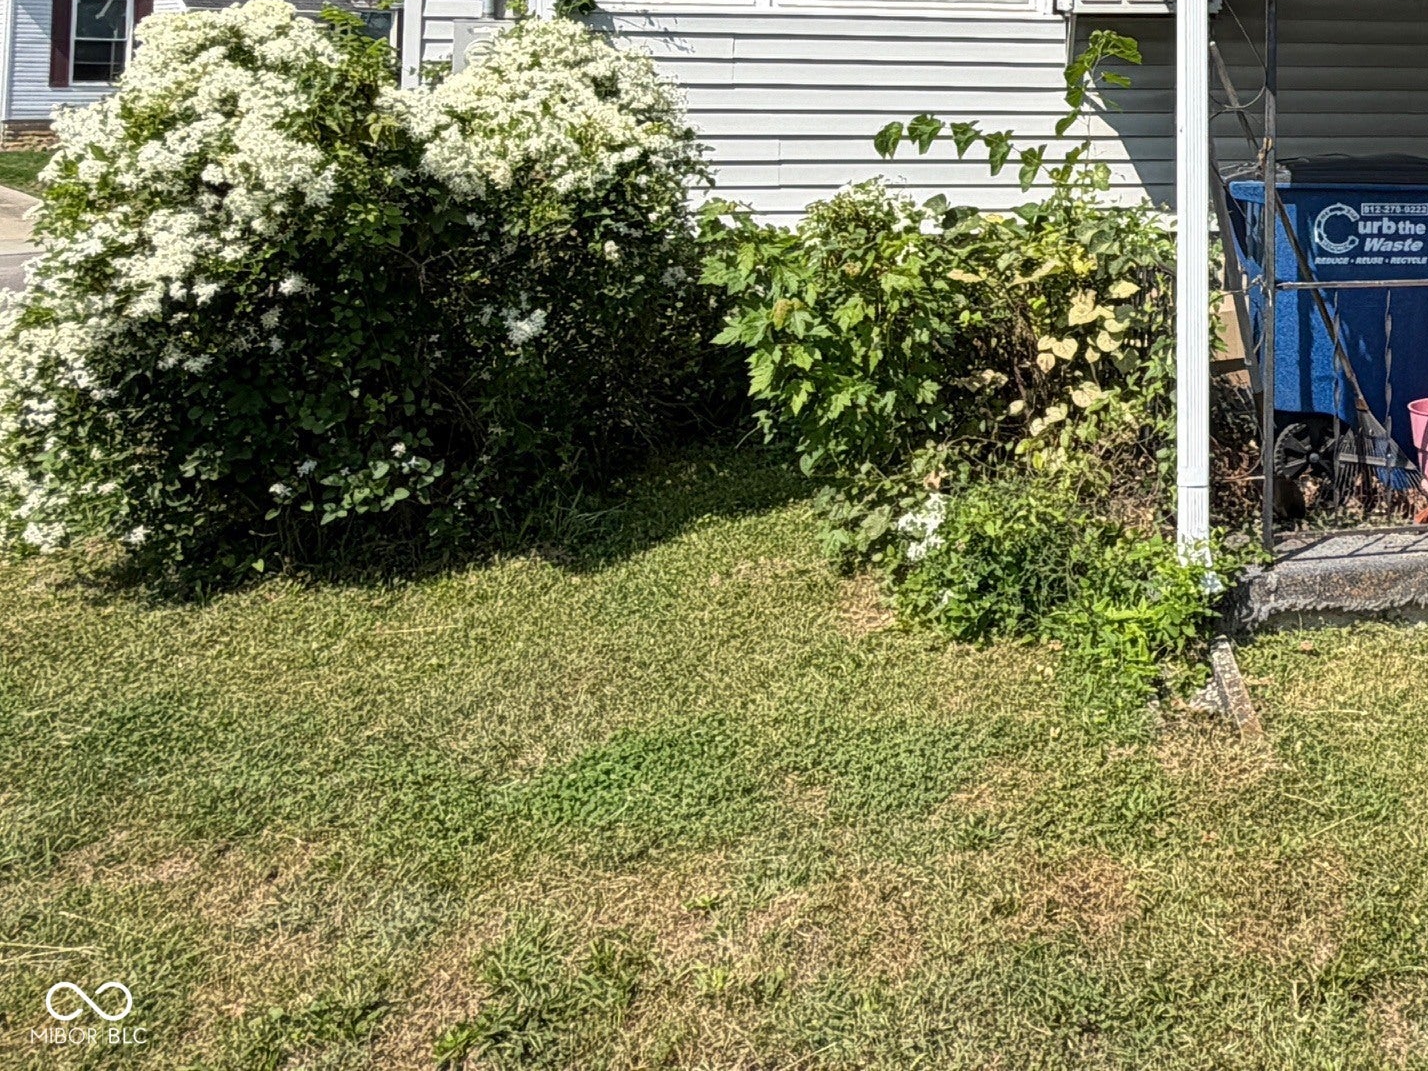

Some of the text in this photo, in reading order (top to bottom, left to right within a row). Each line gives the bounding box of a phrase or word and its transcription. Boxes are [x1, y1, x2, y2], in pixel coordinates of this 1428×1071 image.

[1314, 202, 1426, 254] Curb the
[1364, 237, 1424, 252] Waste
[1314, 256, 1428, 265] REDUCE REUSE RECYCLE
